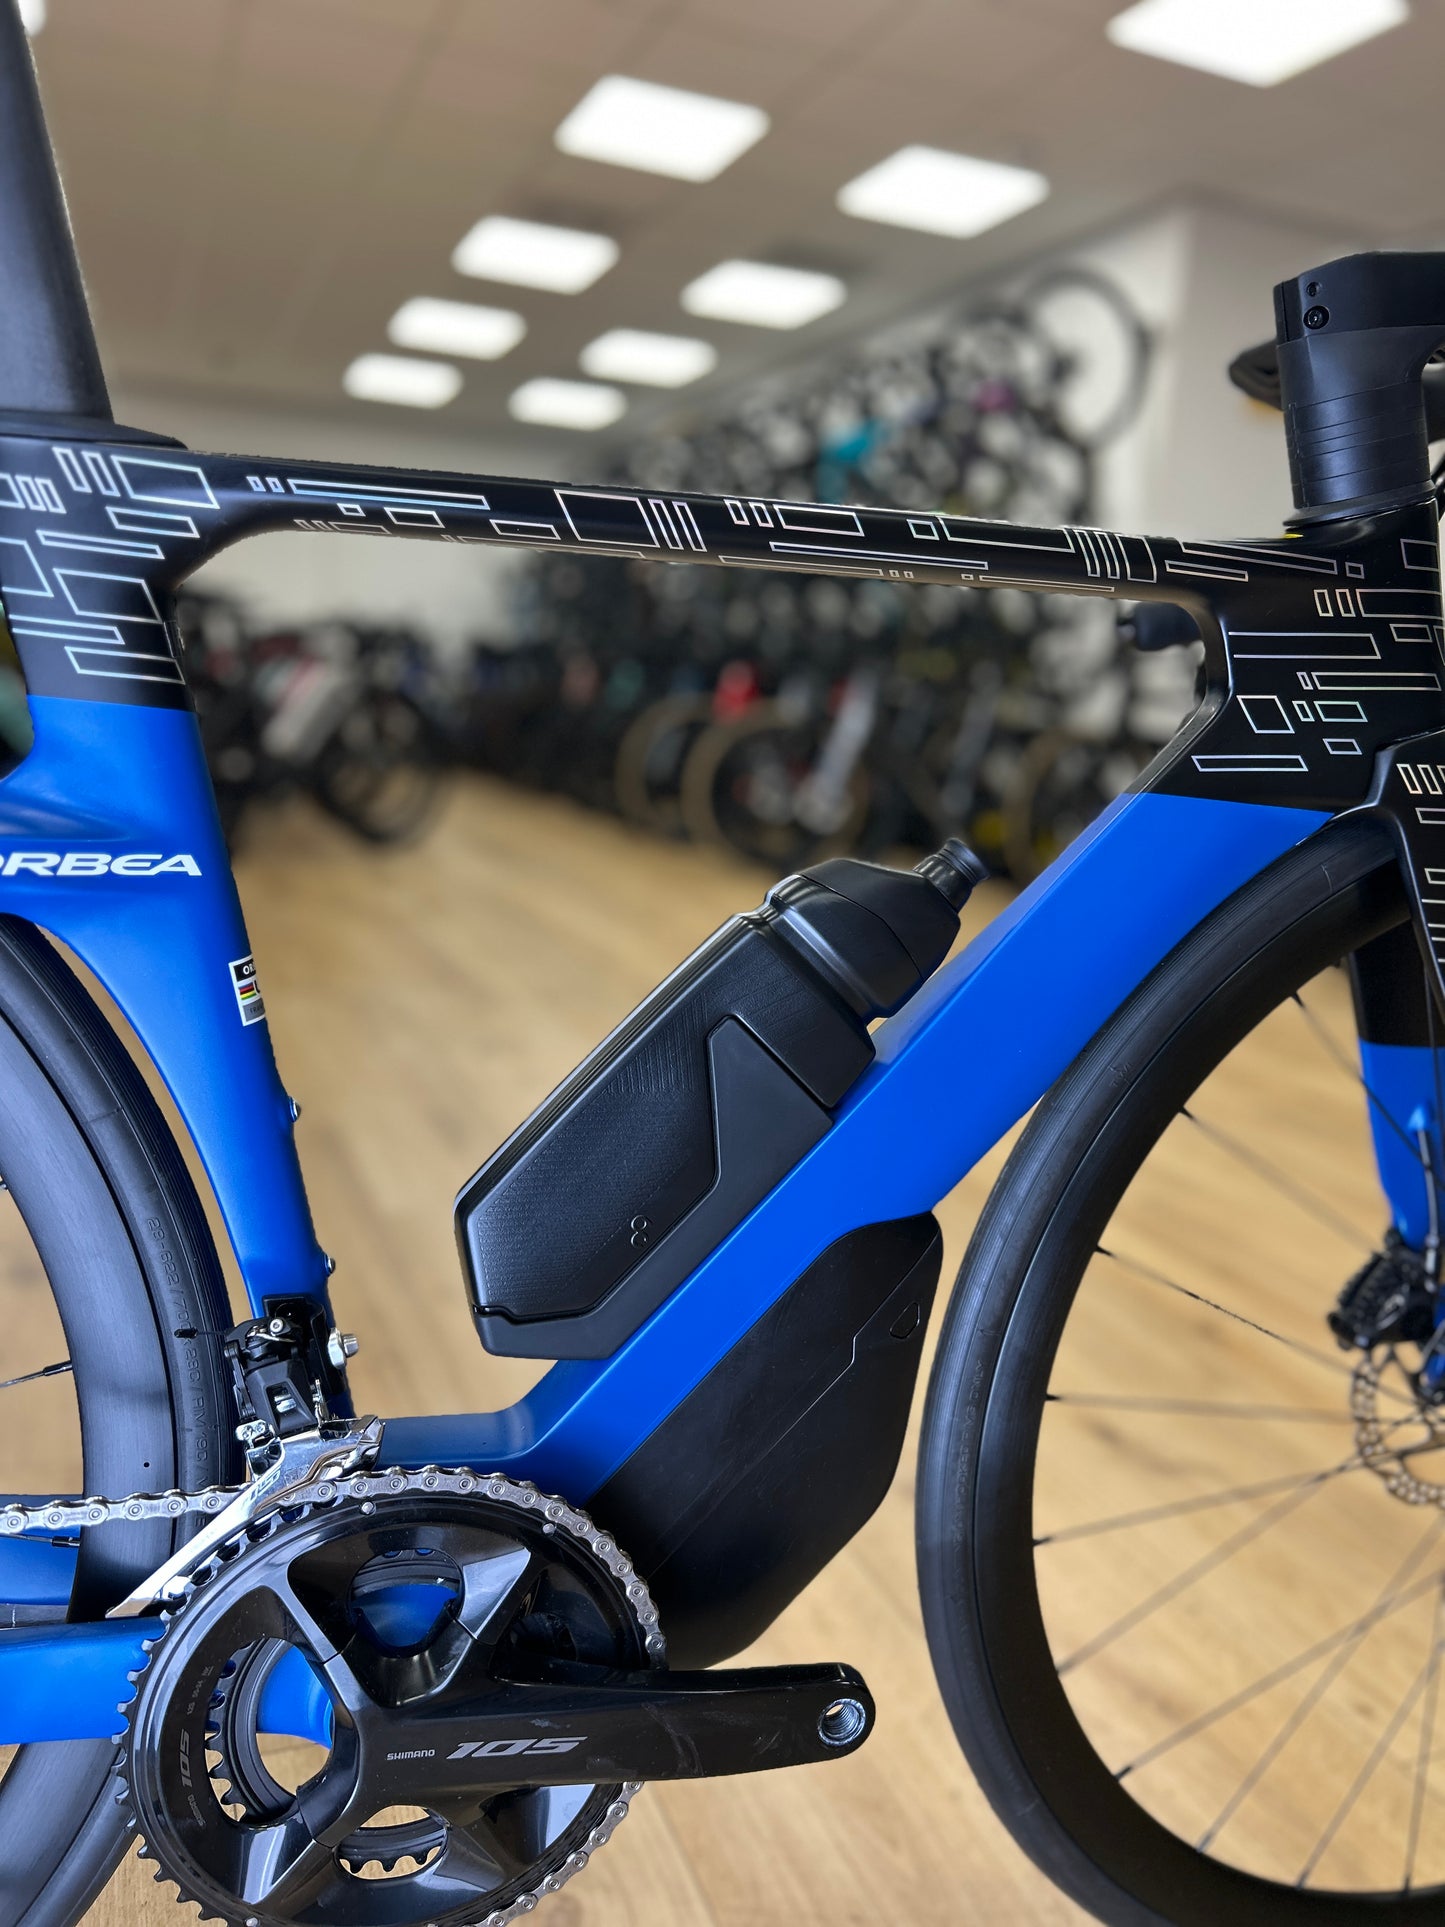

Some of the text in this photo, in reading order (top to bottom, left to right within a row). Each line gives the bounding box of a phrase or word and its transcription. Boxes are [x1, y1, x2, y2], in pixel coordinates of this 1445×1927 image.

[0, 852, 203, 876] RBEA
[147, 1217, 180, 1286] 28-622
[180, 1729, 192, 1787] 105
[387, 1736, 588, 1760] SHIMANO 105
